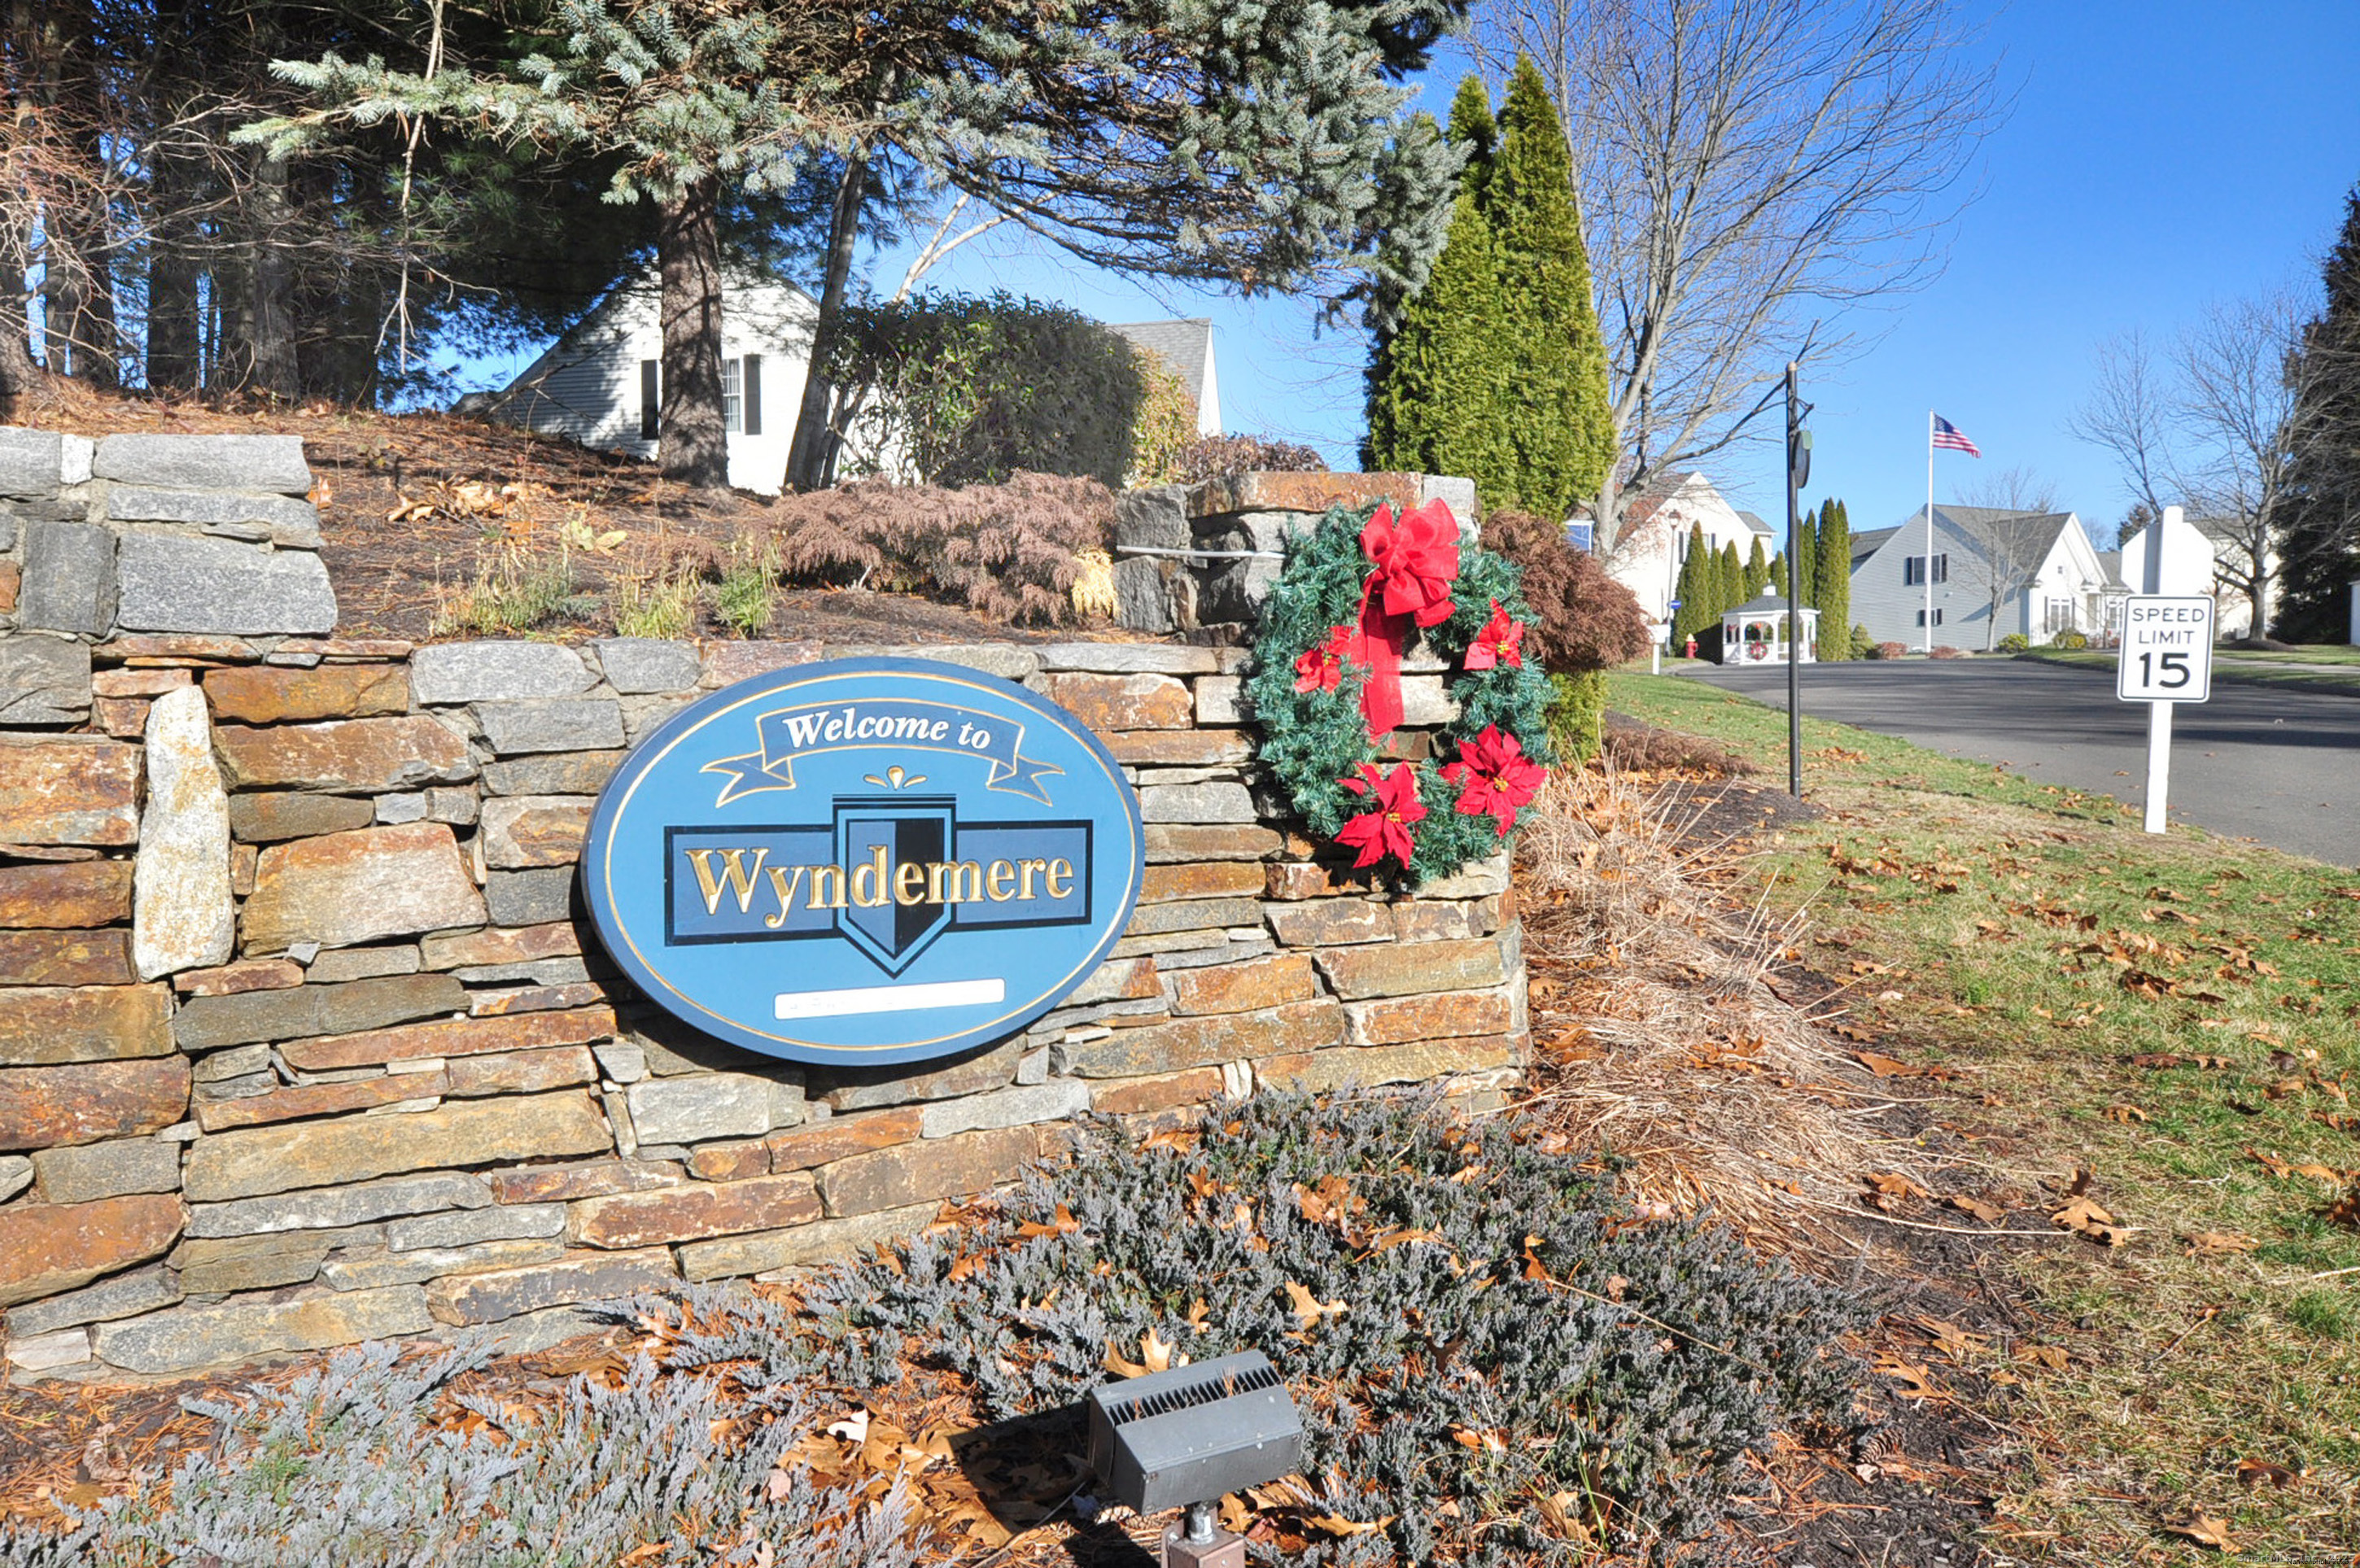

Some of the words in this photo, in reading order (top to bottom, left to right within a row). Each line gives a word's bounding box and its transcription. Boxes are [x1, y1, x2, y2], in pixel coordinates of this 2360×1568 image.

[2132, 607, 2205, 622] SPEED
[2138, 630, 2195, 644] LIMIT
[2139, 652, 2191, 688] 15
[782, 707, 950, 748] Welcome
[957, 721, 991, 749] to
[684, 844, 1073, 929] Wyndemere
